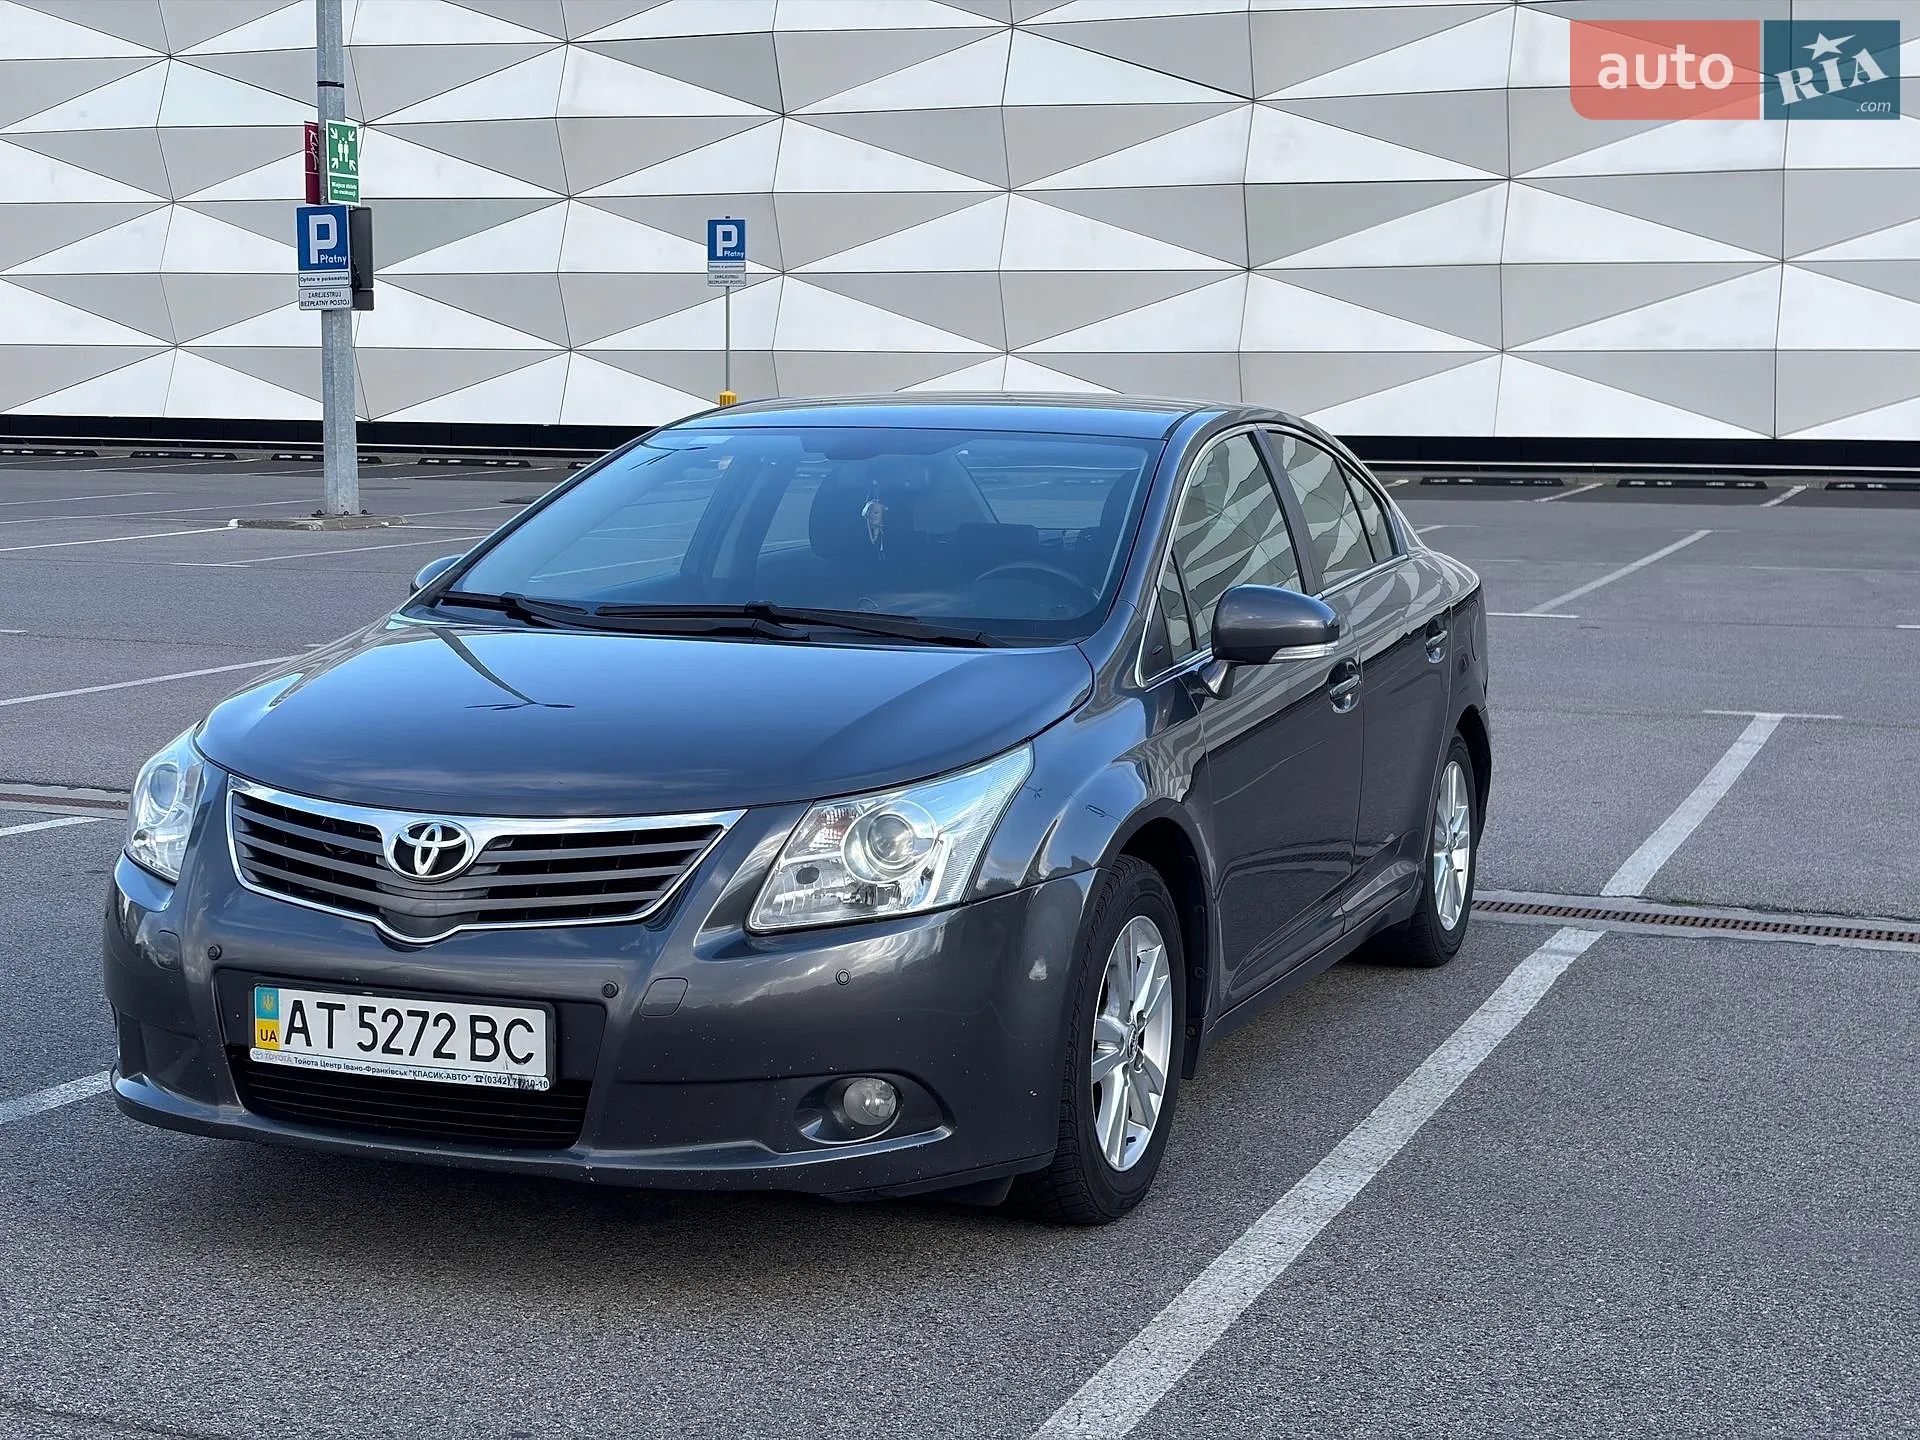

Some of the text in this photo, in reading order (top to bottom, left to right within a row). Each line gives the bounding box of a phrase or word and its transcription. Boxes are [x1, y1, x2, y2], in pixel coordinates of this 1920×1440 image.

[308, 214, 338, 265] P
[716, 224, 738, 257] P
[320, 254, 347, 266] Płatny
[260, 1029, 278, 1042] UA
[284, 999, 535, 1066] AT 5272 BC
[293, 1057, 319, 1067] Тойота
[320, 1060, 342, 1071] Центр
